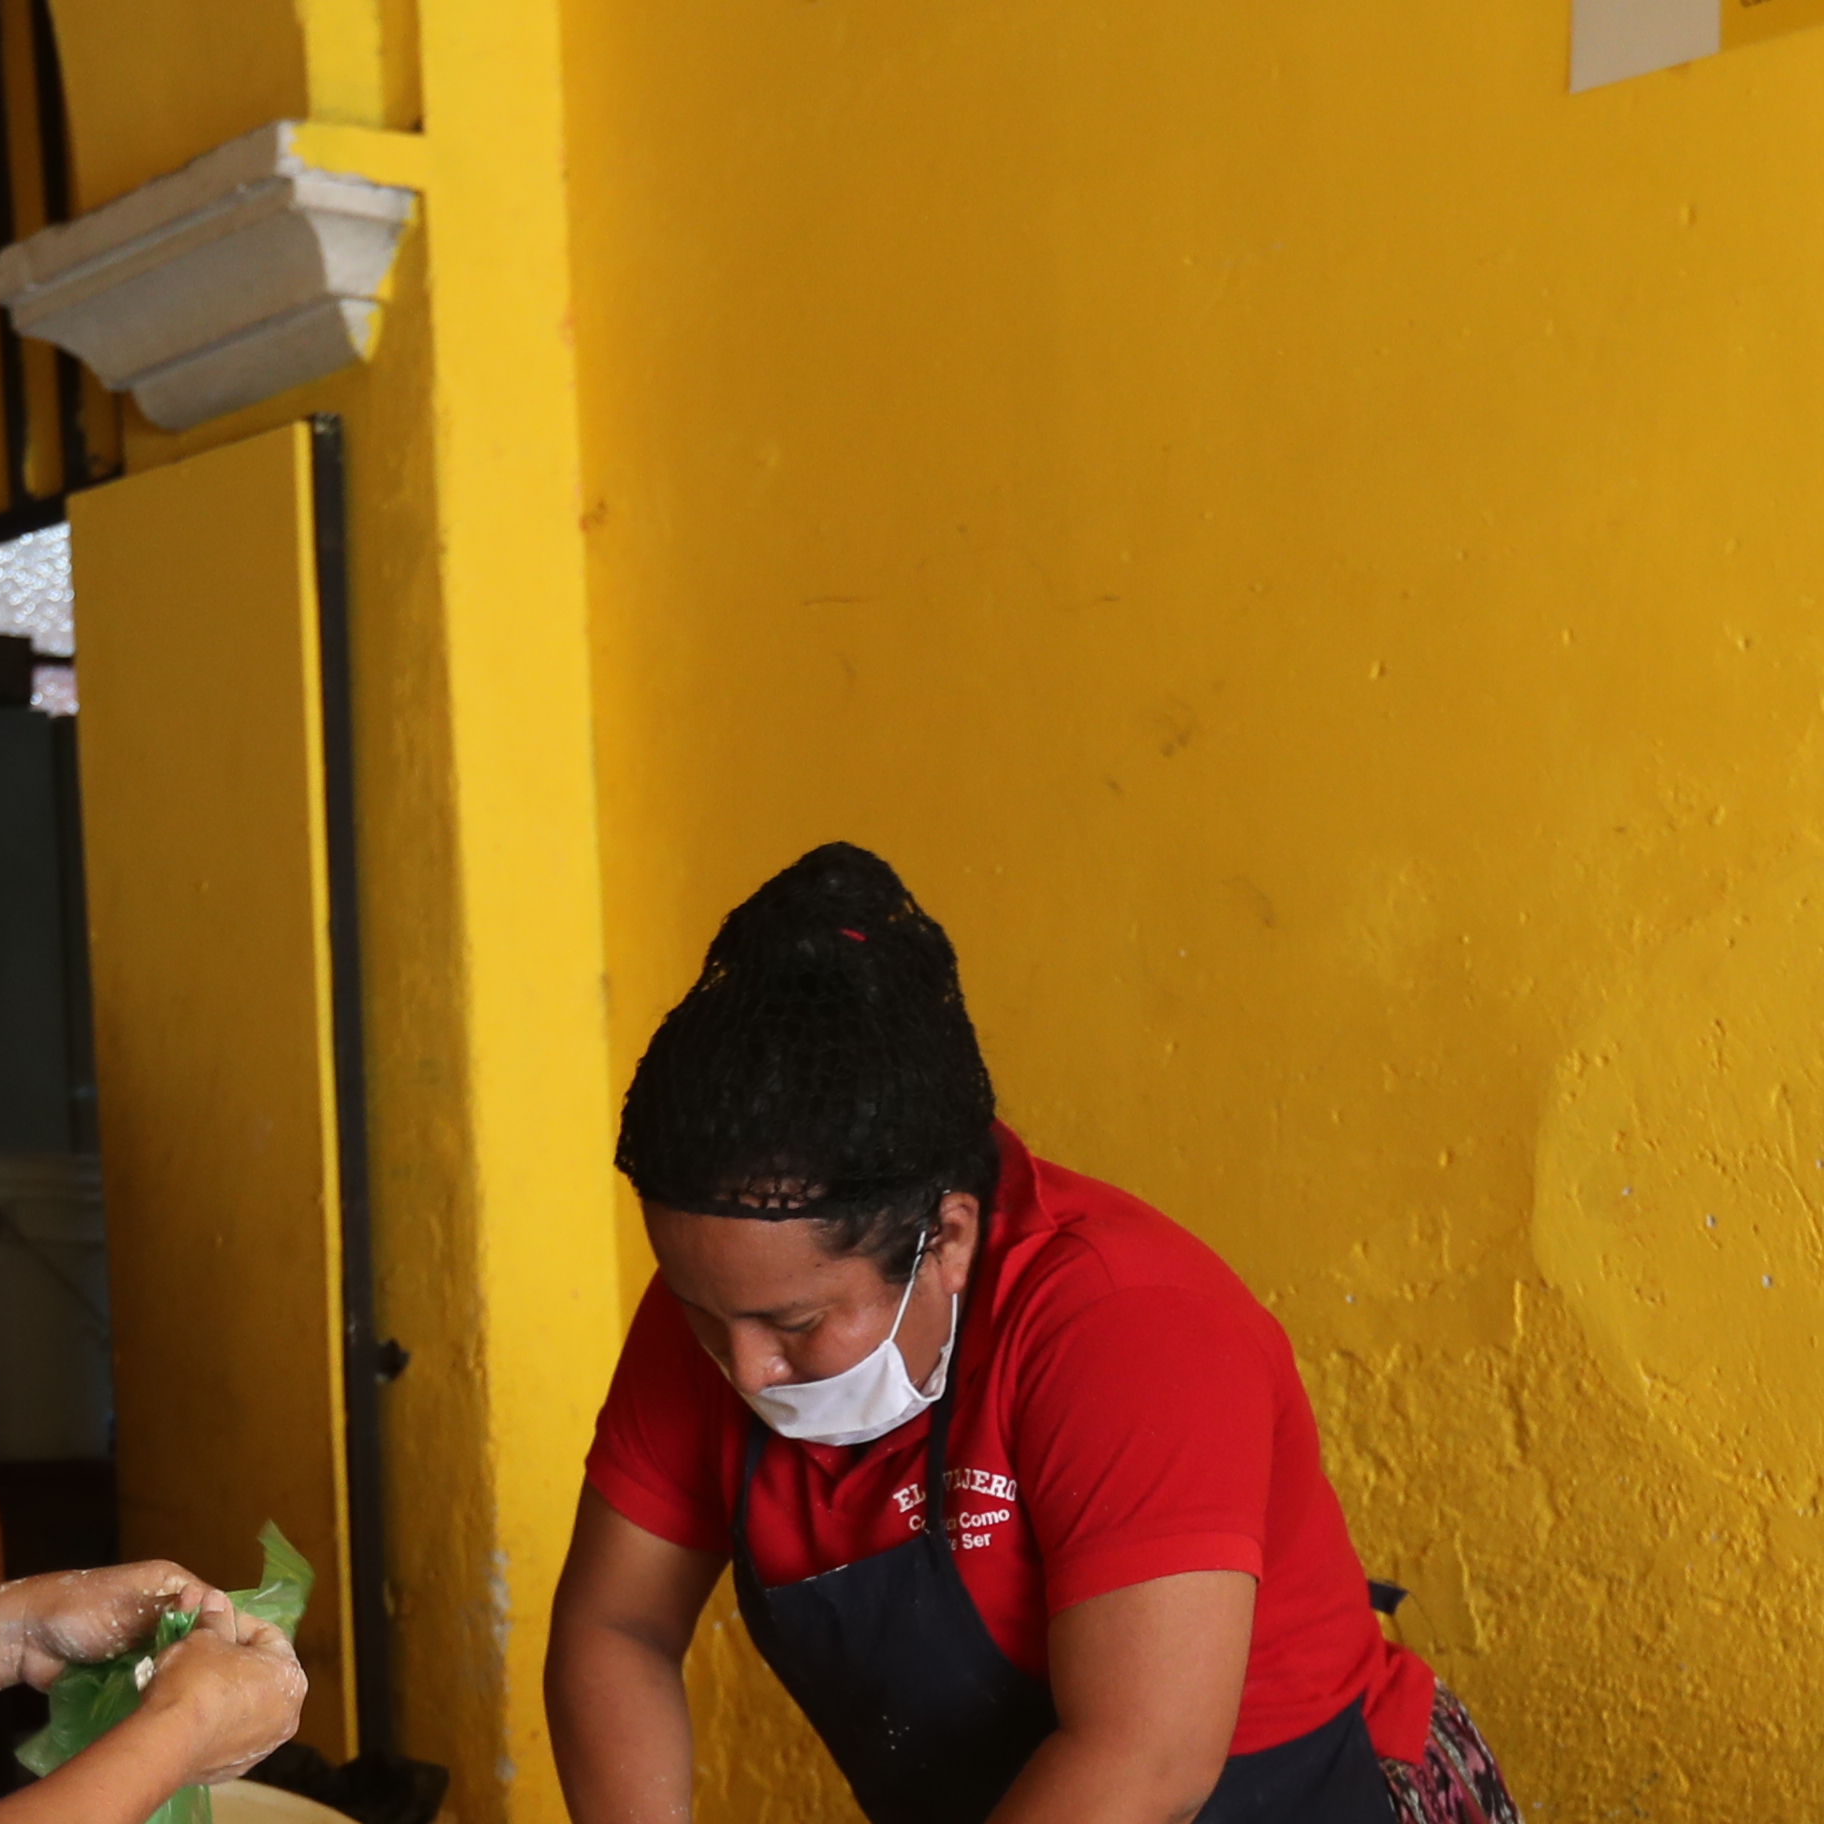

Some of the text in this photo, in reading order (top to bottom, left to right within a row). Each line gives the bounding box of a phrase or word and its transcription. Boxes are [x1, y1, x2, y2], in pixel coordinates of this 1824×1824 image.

[893, 1483, 926, 1513] EL
[959, 1509, 1010, 1529] Como
[962, 1533, 991, 1550] Ser
